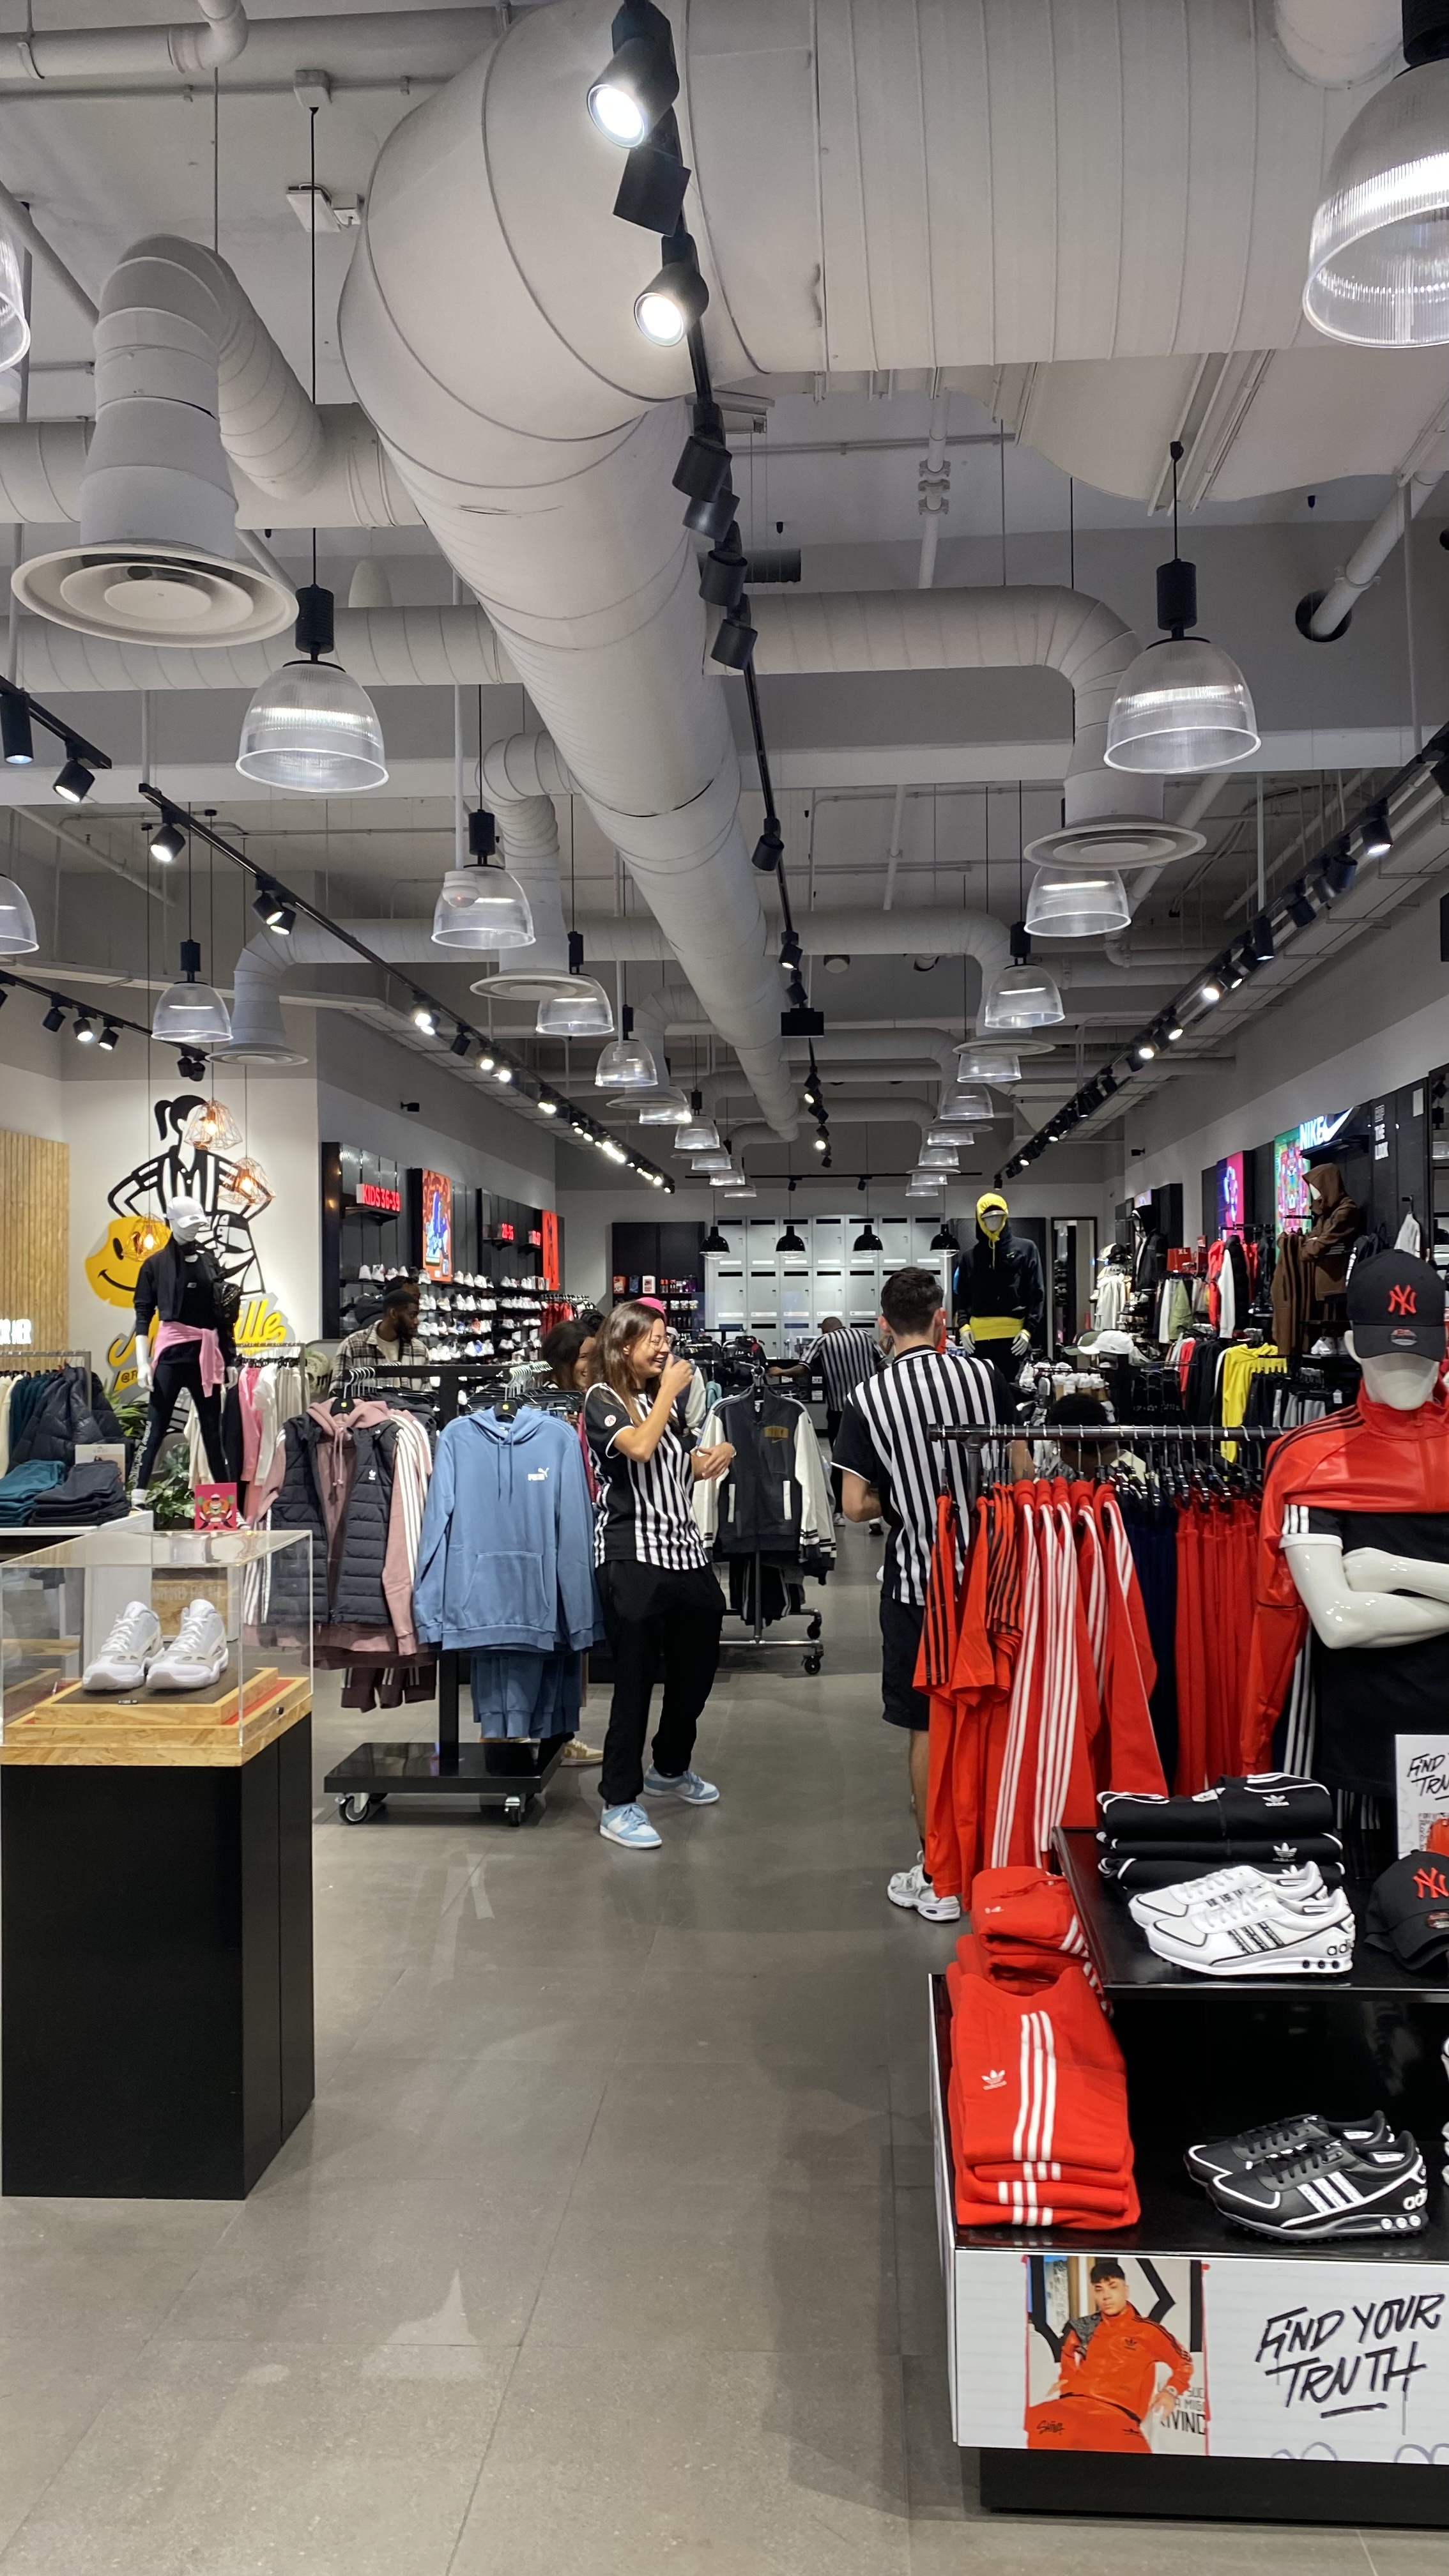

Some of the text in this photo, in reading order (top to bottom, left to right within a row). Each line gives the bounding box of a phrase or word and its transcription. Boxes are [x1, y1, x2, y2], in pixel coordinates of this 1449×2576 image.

[1300, 1116, 1325, 1150] NIKE
[362, 1183, 401, 1212] KIDS 36-39
[1387, 1284, 1417, 1316] NY
[1412, 1867, 1449, 1899] NY
[1351, 2293, 1446, 2344] YOUR
[1265, 2341, 1427, 2408] TRUTH
